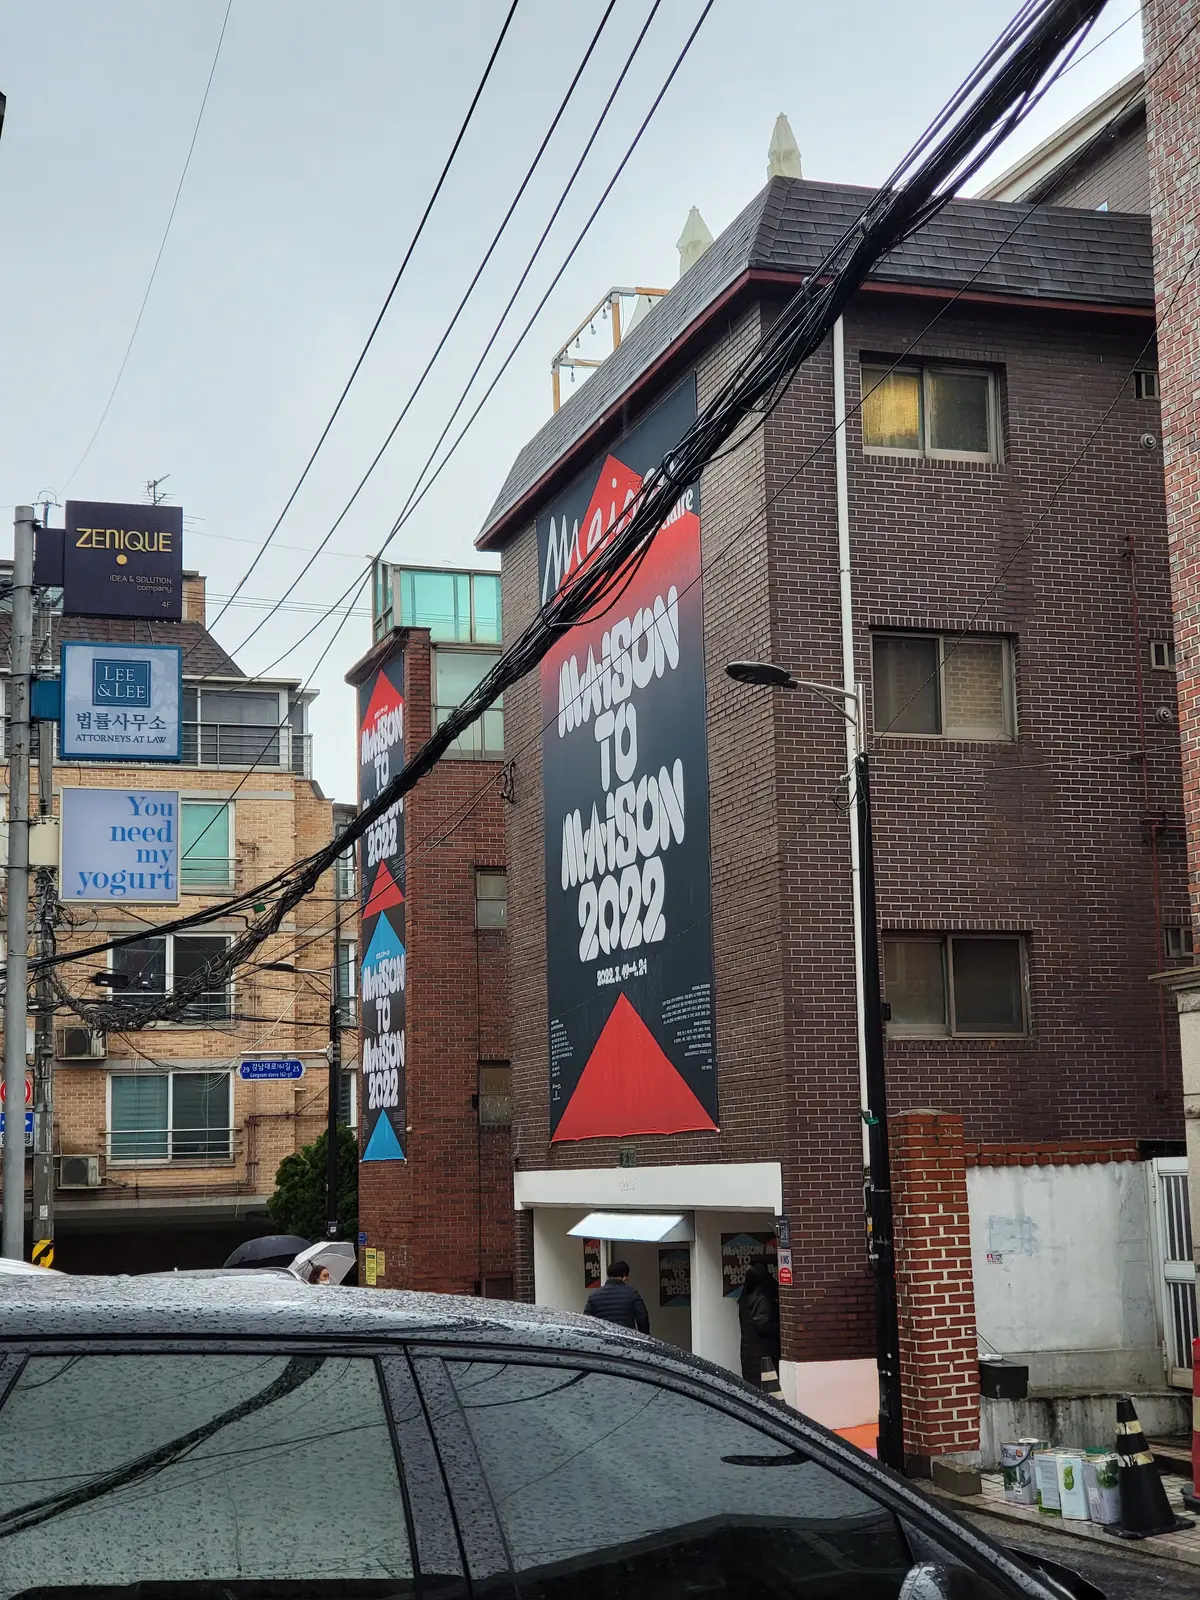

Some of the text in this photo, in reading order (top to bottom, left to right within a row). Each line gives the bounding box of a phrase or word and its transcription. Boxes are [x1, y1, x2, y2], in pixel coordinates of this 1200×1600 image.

[75, 528, 172, 552] ZENIQUE
[109, 574, 172, 584] IDEA & SOLUTION
[137, 585, 172, 594] company
[161, 601, 172, 609] 4F
[558, 585, 679, 738] MAISON
[103, 666, 135, 682] LEE
[114, 682, 146, 699] LEE
[76, 712, 167, 732] 법률사무소
[75, 733, 167, 744] ATTORNEYS AT LAW
[361, 703, 403, 766] MAISON
[594, 701, 637, 792] TO
[374, 751, 389, 788] TO
[127, 796, 173, 817] You
[109, 820, 173, 843] need
[561, 758, 685, 891] MAISON
[367, 818, 397, 867] 2022
[136, 847, 173, 868] my
[76, 867, 174, 895] yogurt
[578, 855, 666, 963] 2022
[363, 954, 405, 1002] MAISON
[375, 997, 391, 1034] TO
[363, 1030, 405, 1074] MAISON
[293, 1065, 300, 1073] 25
[368, 1069, 398, 1109] 2022
[737, 1255, 751, 1265] TO
